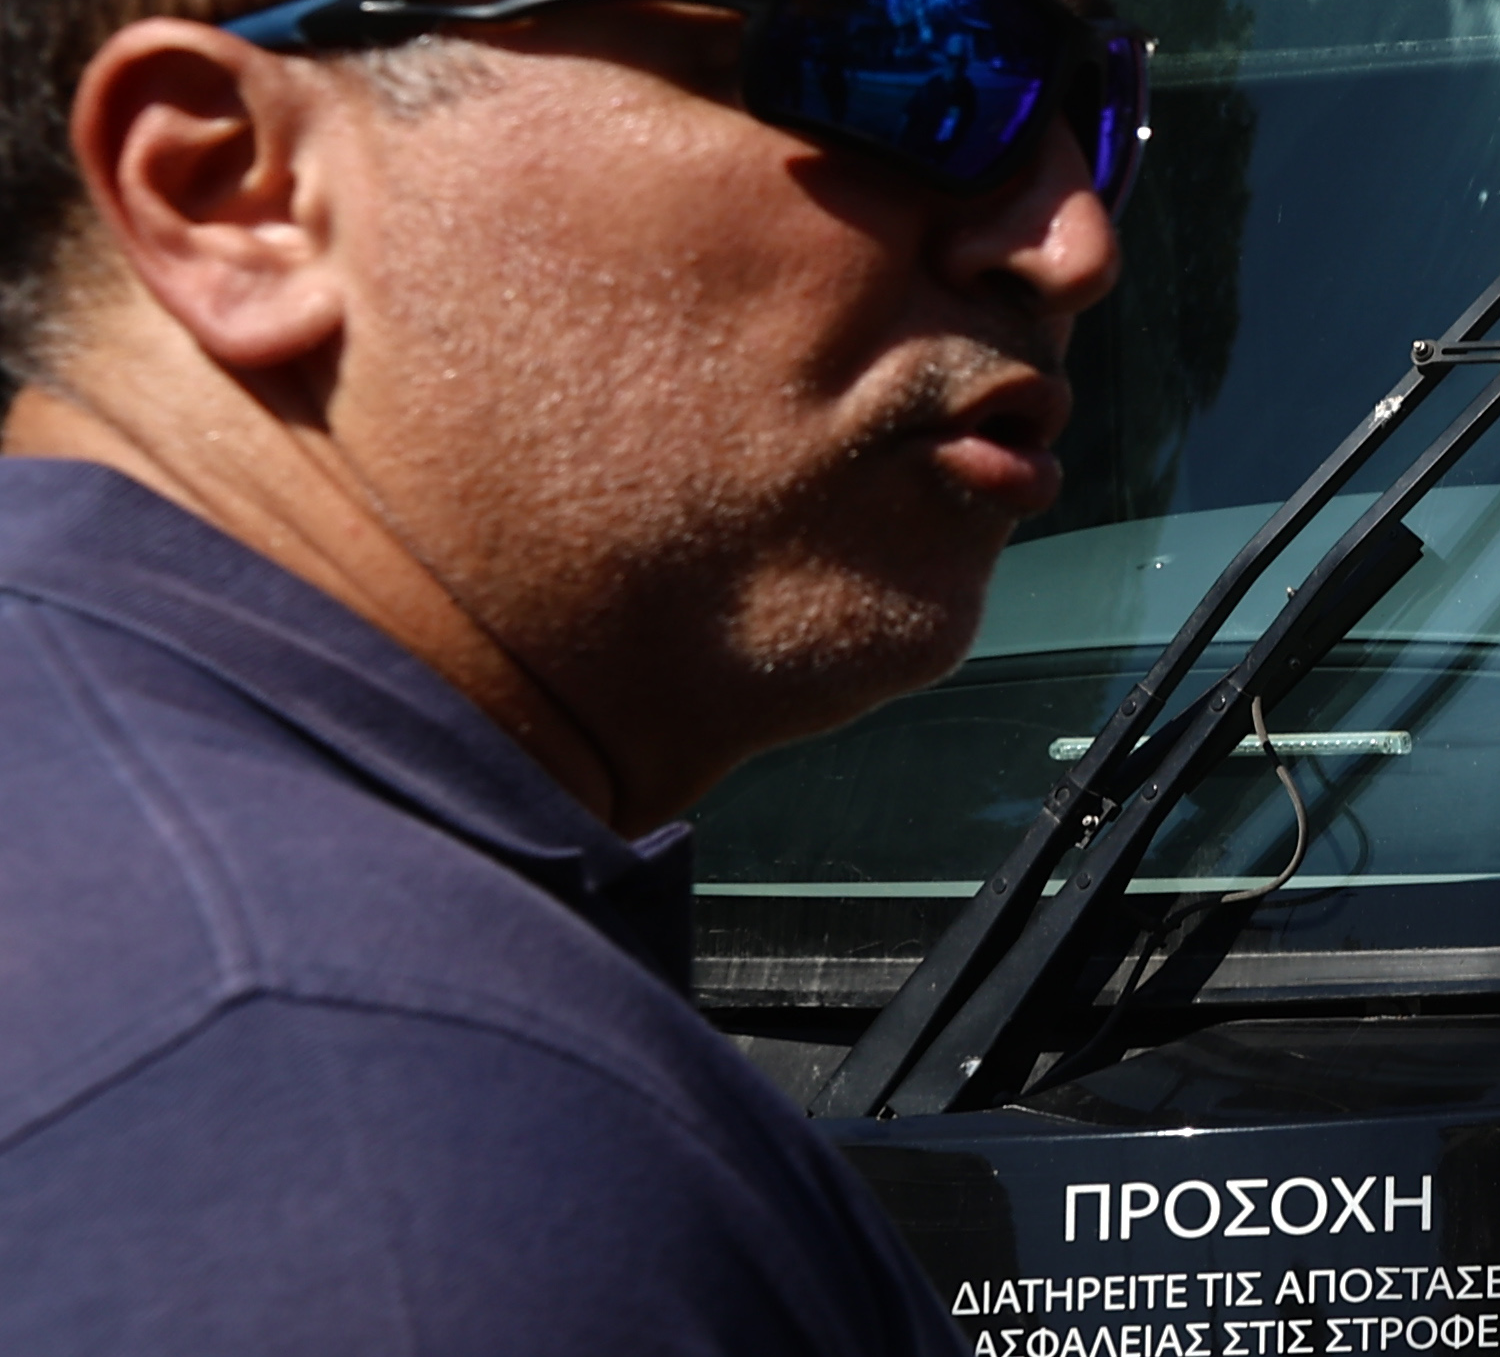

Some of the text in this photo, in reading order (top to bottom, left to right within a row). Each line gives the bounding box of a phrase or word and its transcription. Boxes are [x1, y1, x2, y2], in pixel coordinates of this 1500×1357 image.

[1064, 1174, 1433, 1243] ΠΡΟΣΟΧΗ
[951, 1273, 1188, 1316] ΔΙΑΤΗΡΕΙΤΕ
[1196, 1271, 1263, 1308] ΤΙΣ
[1222, 1319, 1314, 1357] ΣΤΙΣ
